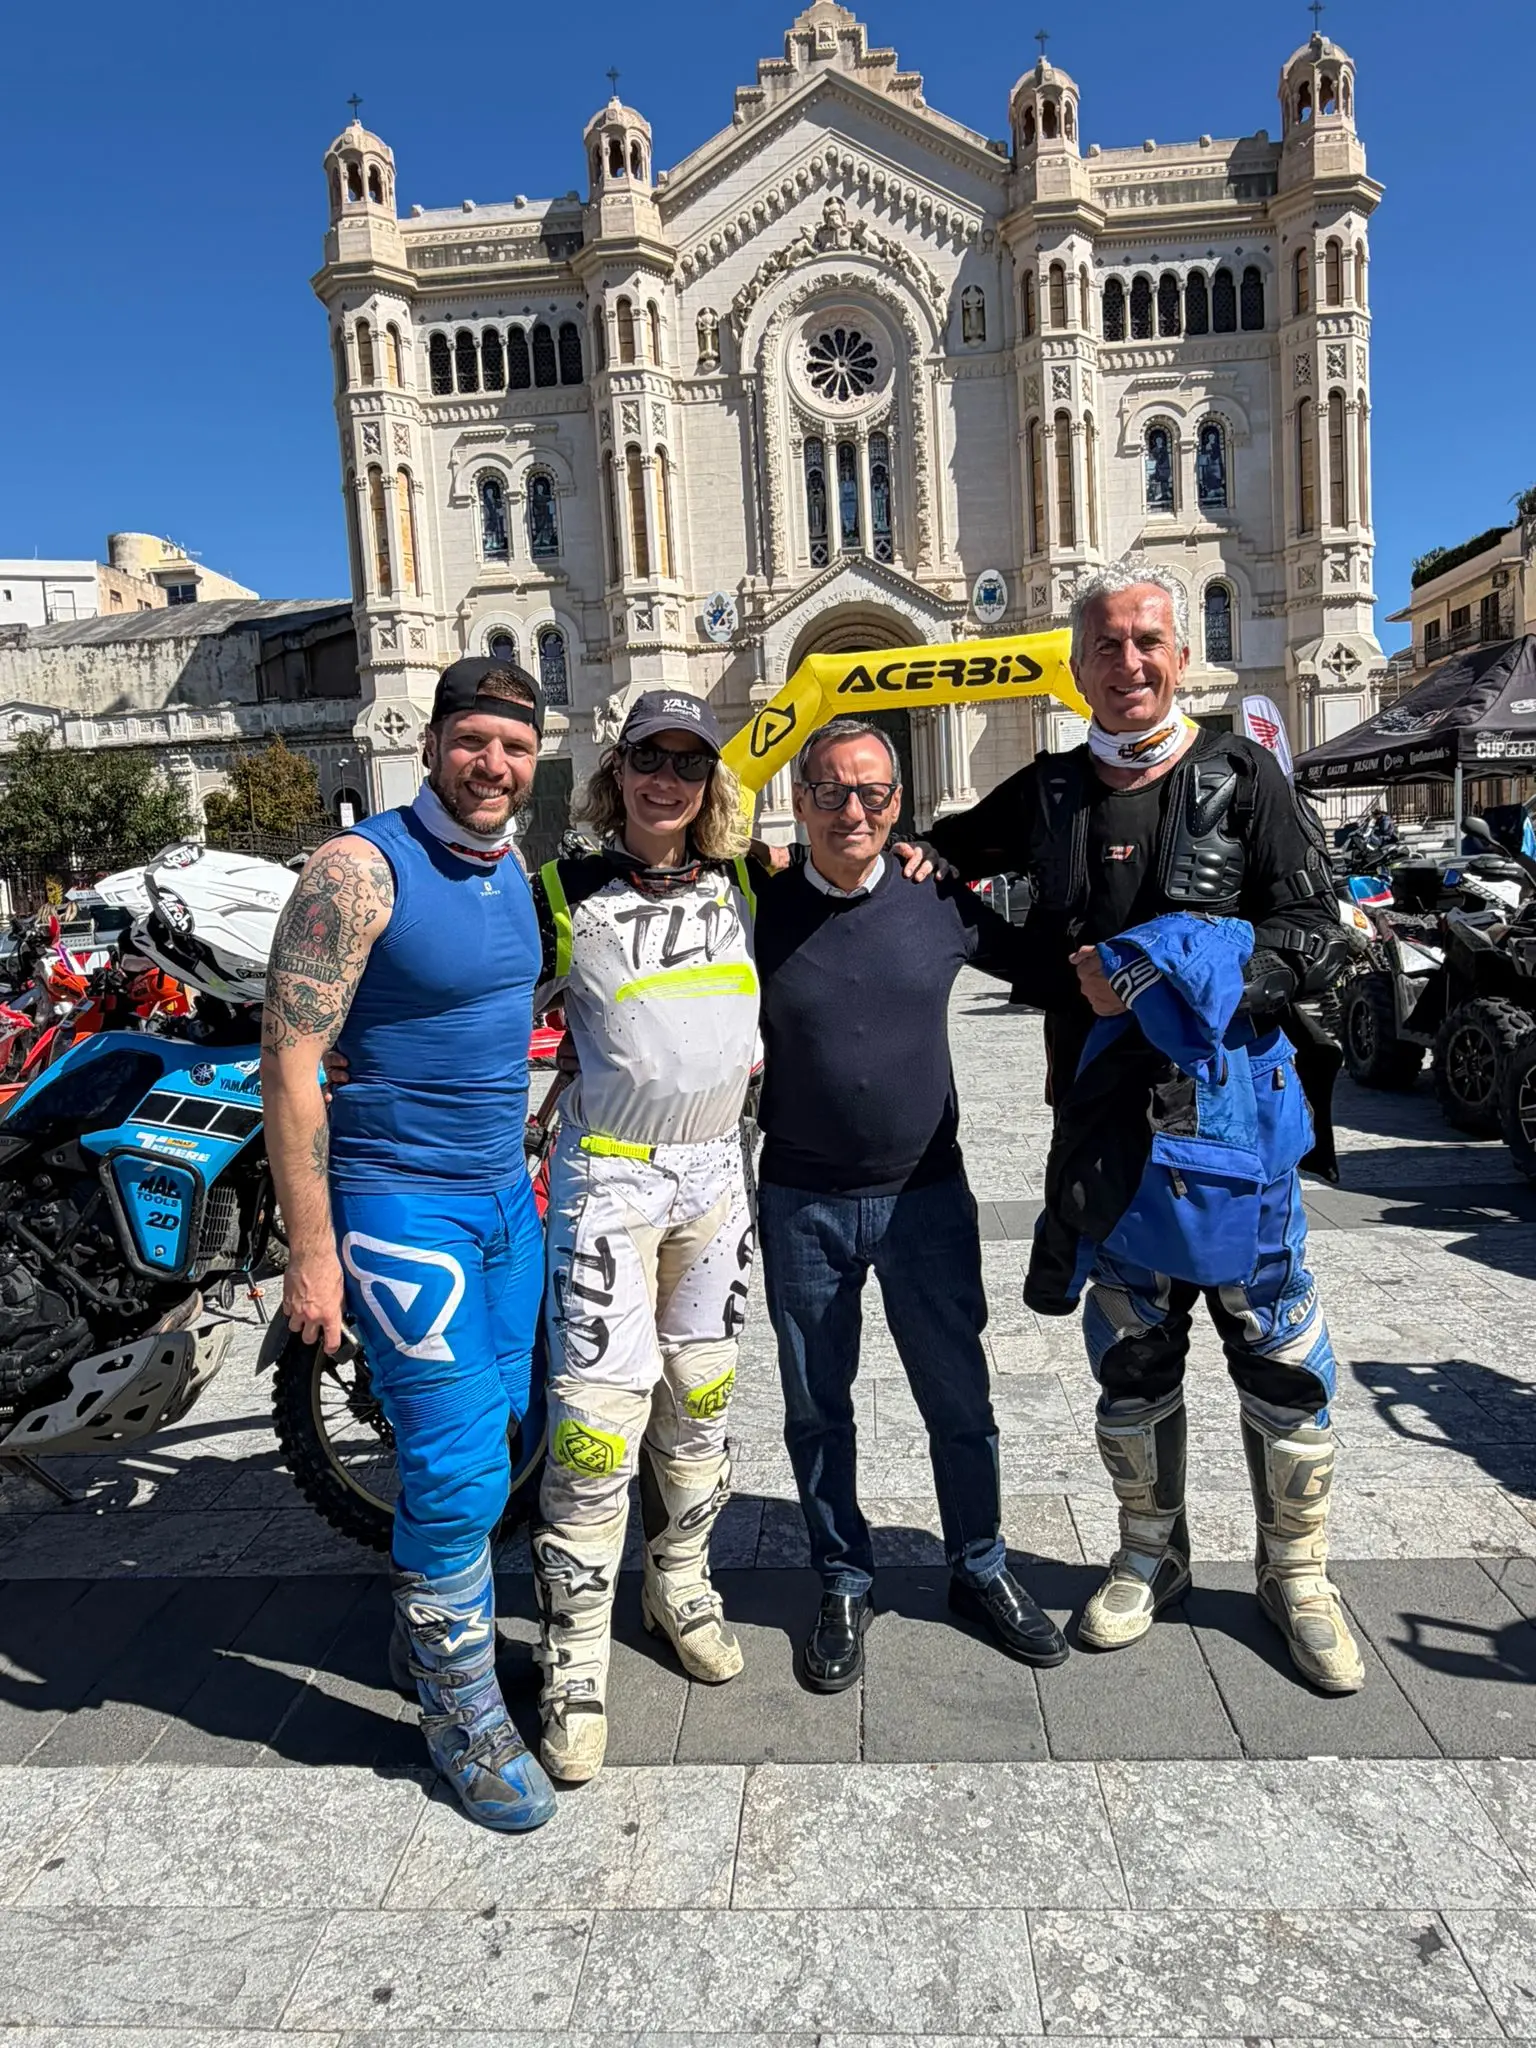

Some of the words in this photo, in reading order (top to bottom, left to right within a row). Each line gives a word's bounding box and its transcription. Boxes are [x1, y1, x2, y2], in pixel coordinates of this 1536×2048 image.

[837, 655, 1043, 694] ACERBIS
[614, 900, 740, 970] TLD
[137, 1190, 179, 1207] TOOLS
[145, 1211, 181, 1231] 2D
[553, 1236, 616, 1369] TLD
